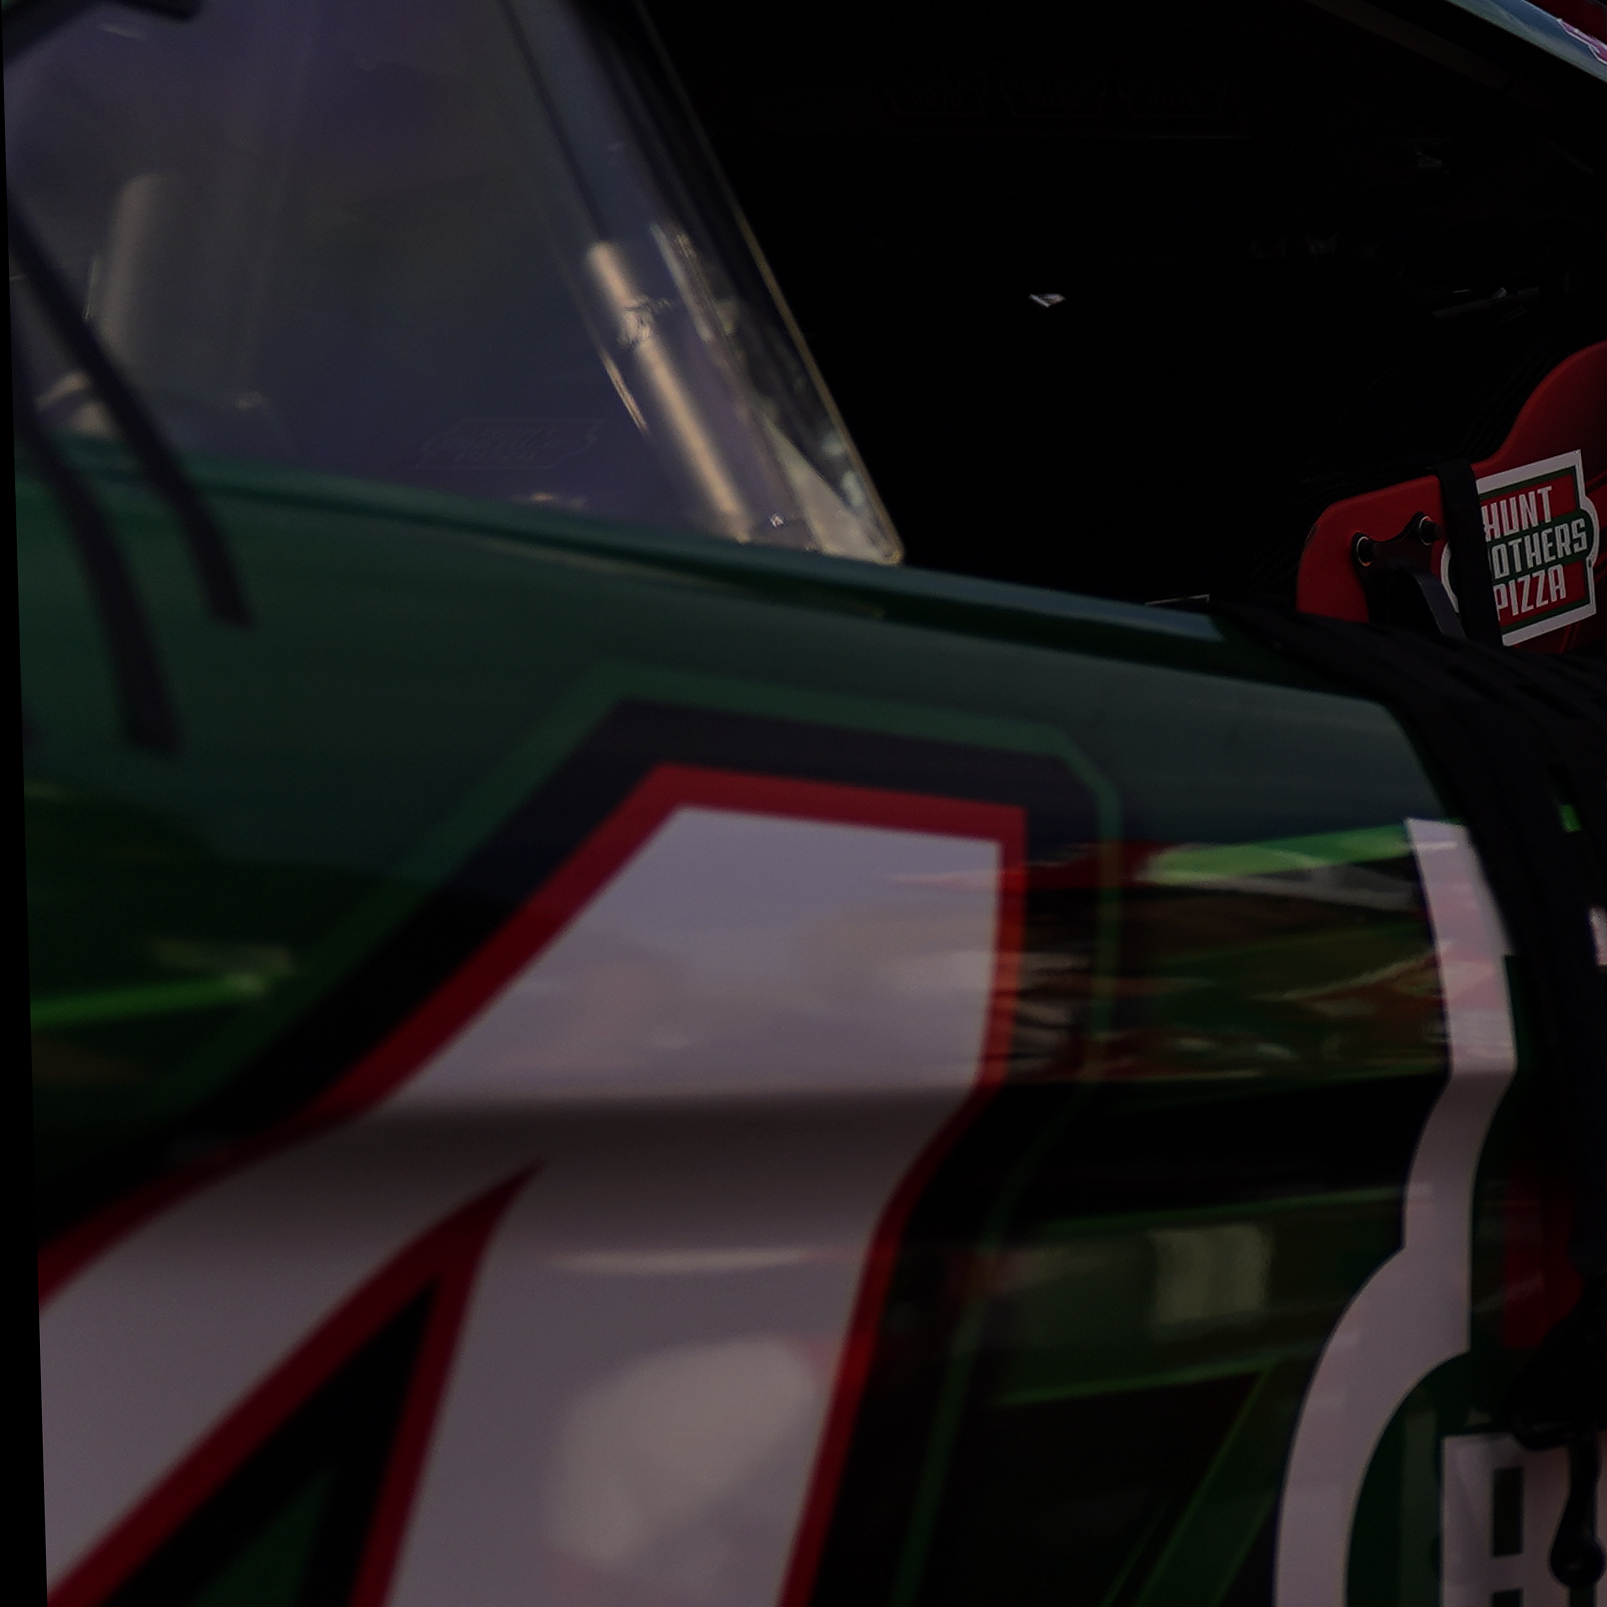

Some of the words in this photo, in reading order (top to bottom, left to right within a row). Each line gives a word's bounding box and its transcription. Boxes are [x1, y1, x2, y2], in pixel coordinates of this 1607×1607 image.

[1480, 485, 1553, 543] HUNT
[1488, 517, 1588, 580] OTHERS
[1493, 563, 1567, 622] PIZZA
